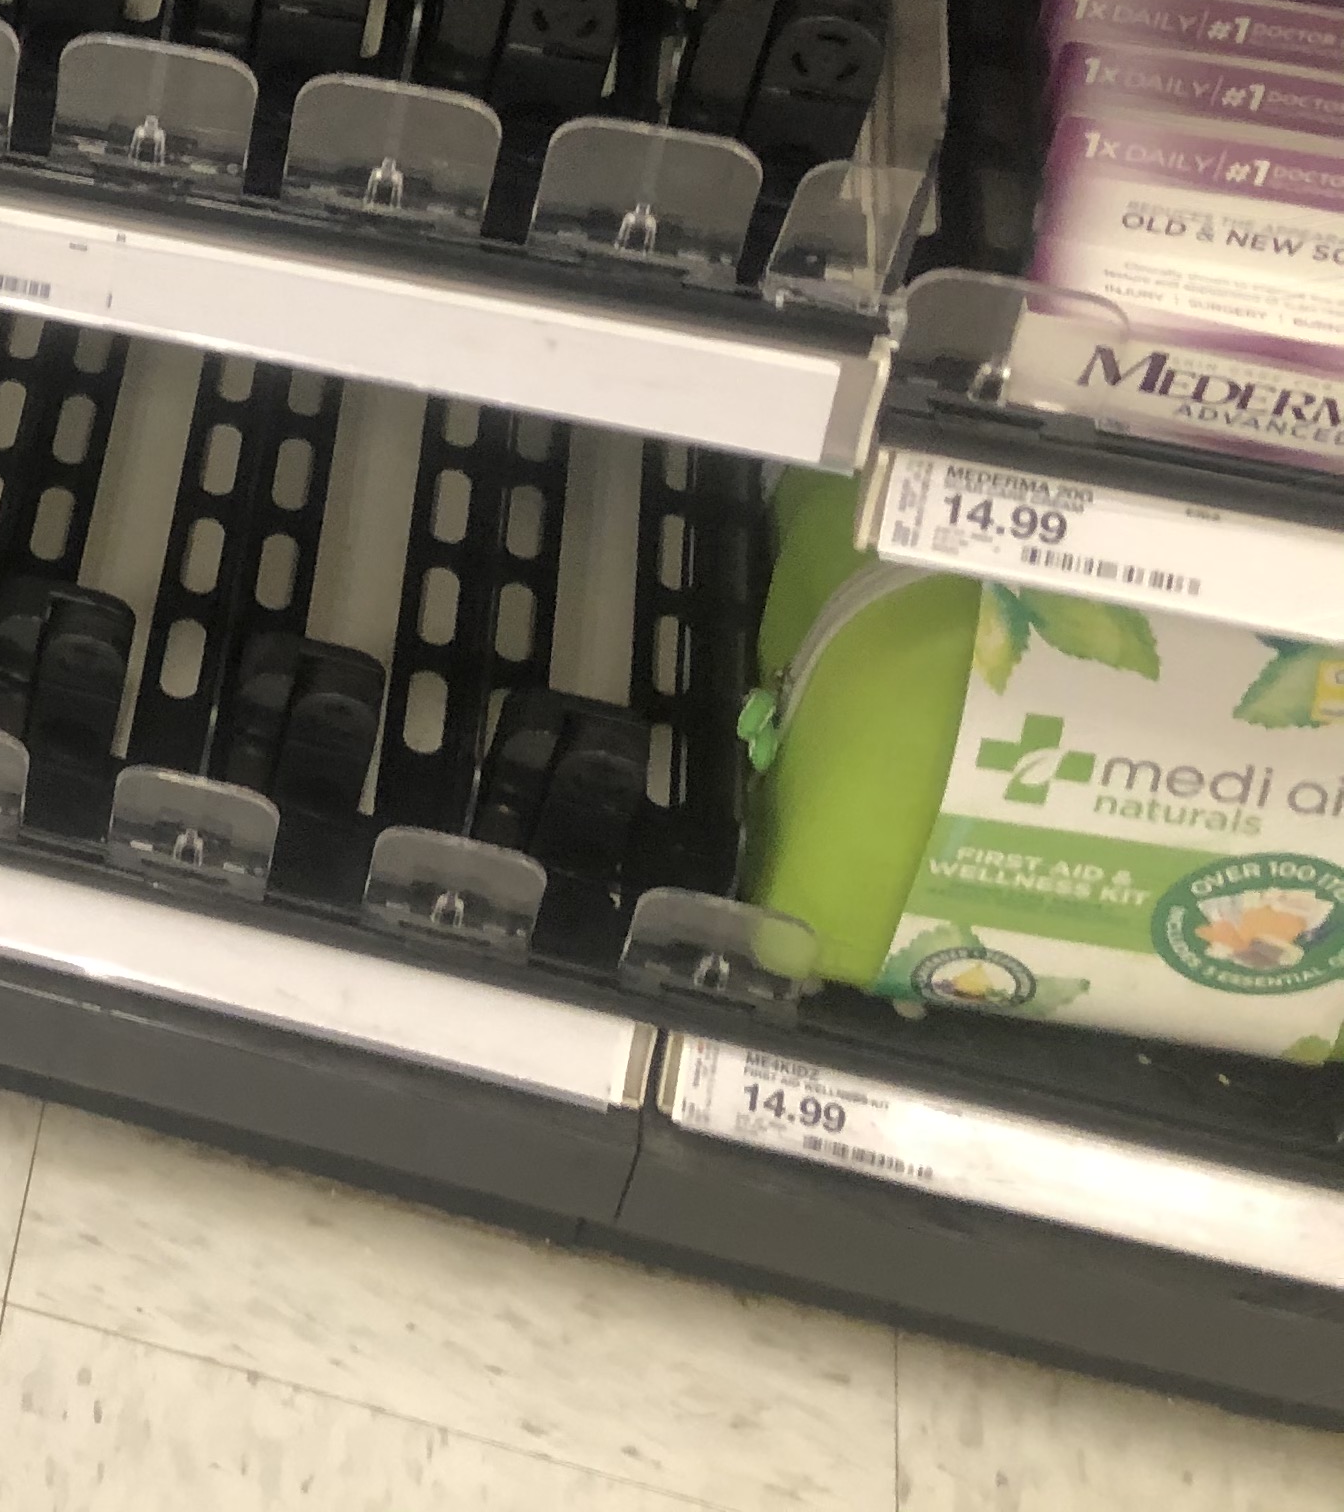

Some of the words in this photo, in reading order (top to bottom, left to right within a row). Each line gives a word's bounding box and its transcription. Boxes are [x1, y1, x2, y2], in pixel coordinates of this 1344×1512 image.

[1121, 211, 1188, 237] OLD
[1194, 224, 1215, 244] &
[1224, 228, 1305, 258] NEW
[943, 492, 1068, 545] 14.99
[1100, 755, 1274, 808] medi
[1092, 793, 1263, 836] naturals
[928, 857, 1093, 901] WELLNESS
[1098, 885, 1152, 906] KIT
[954, 845, 1044, 873] FIRST
[1053, 859, 1105, 882] AID
[1110, 868, 1134, 886] &
[1267, 860, 1318, 882] 100
[742, 1082, 847, 1134] 14.99
